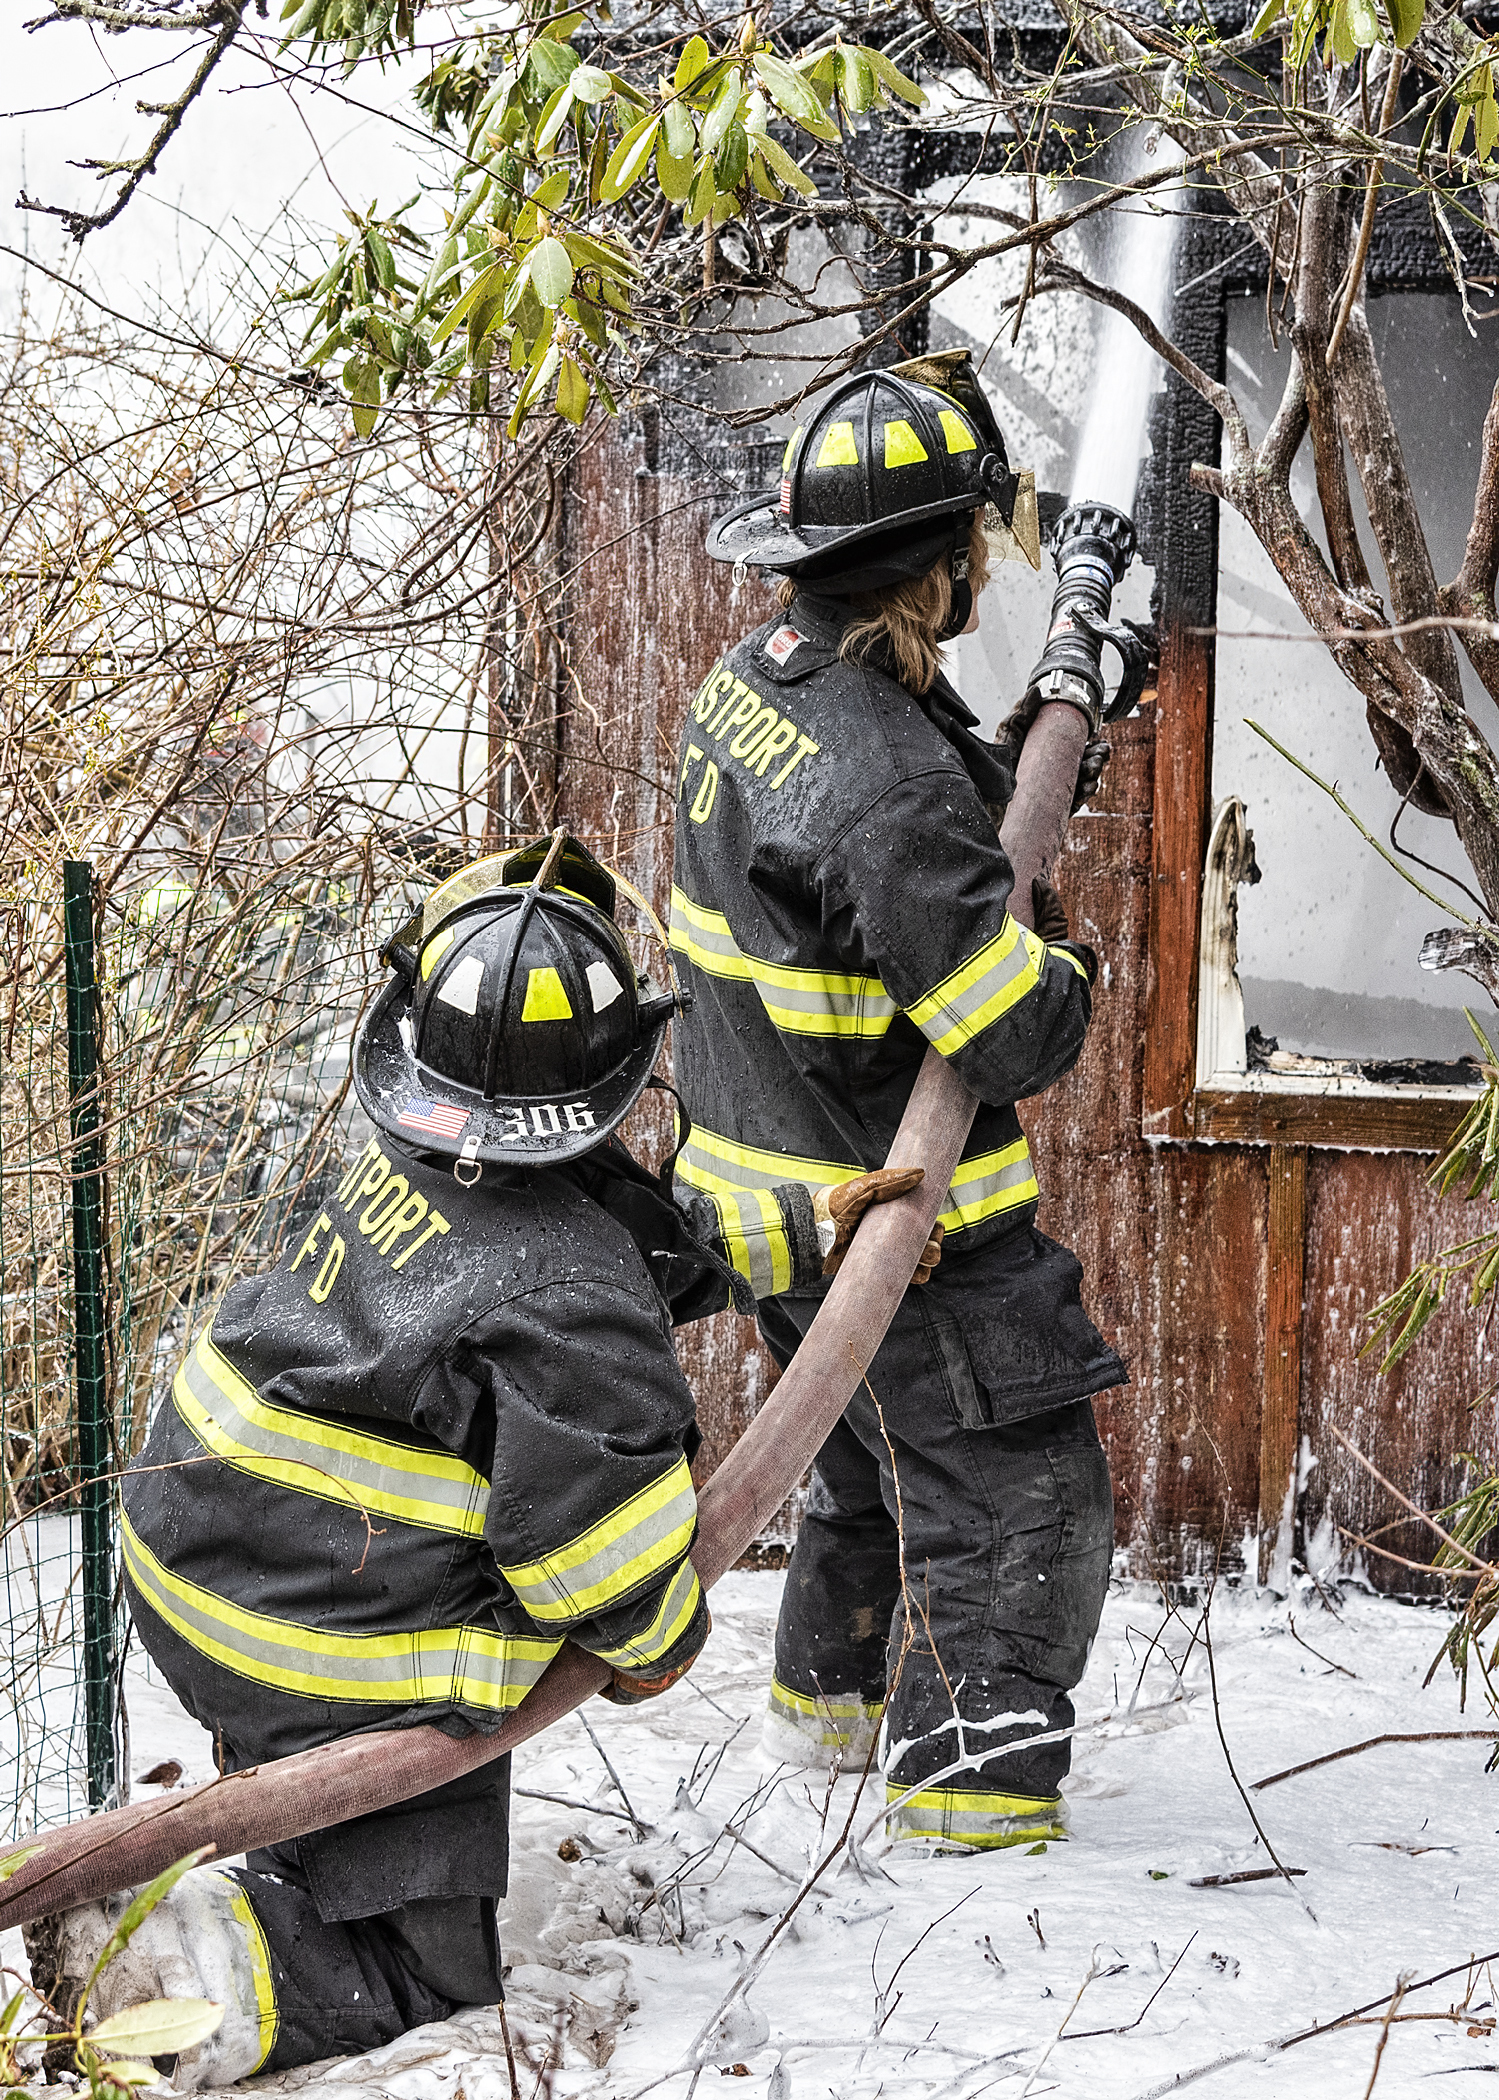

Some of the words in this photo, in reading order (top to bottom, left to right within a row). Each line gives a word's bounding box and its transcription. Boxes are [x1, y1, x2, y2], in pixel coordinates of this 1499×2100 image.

[691, 659, 820, 790] STPORT
[689, 760, 718, 824] D
[336, 1134, 452, 1271] TPORT
[290, 1212, 332, 1273] F
[308, 1233, 346, 1304] D
